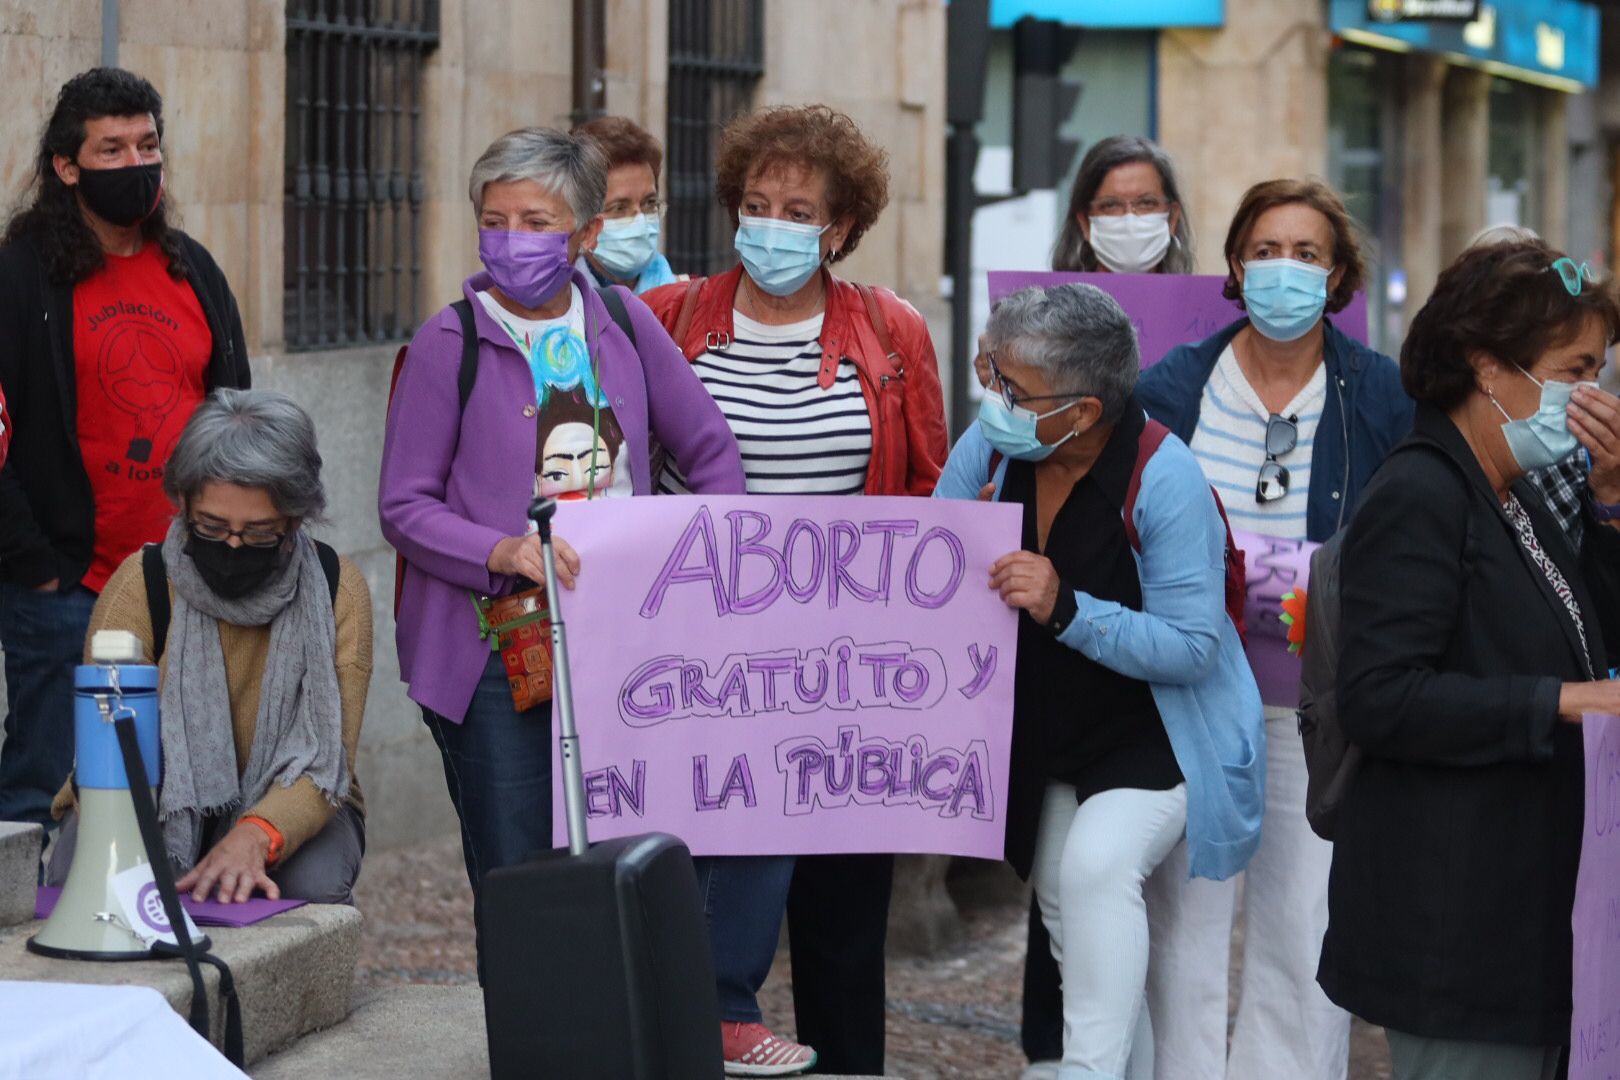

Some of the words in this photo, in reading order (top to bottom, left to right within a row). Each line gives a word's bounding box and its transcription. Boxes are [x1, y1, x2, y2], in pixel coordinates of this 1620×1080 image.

[104, 460, 121, 475] a
[639, 505, 966, 618] ABORTO
[585, 759, 647, 819] EN
[693, 753, 757, 812] LA
